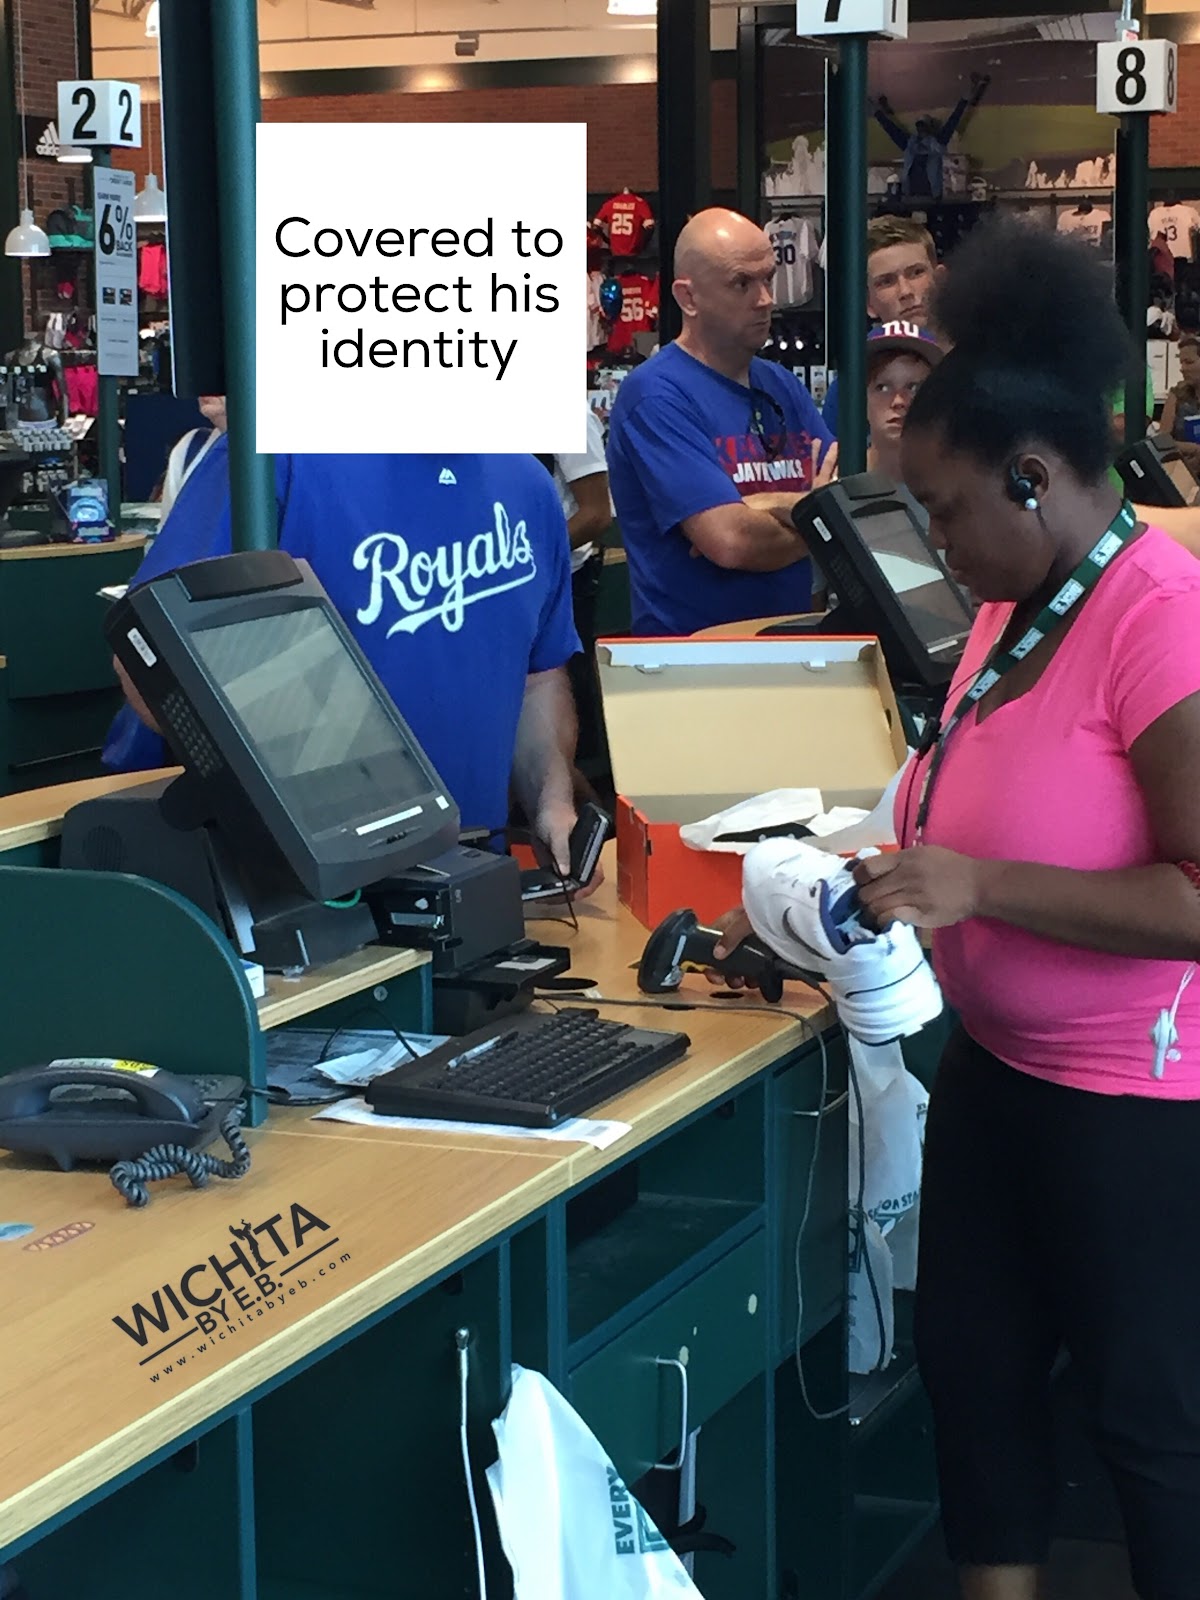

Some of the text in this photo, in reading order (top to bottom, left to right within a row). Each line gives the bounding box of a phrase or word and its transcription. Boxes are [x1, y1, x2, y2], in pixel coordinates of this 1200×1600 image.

[1115, 46, 1147, 106] 8
[1166, 47, 1175, 107] 8
[71, 87, 97, 140] 2
[118, 89, 134, 142] 2
[611, 213, 634, 235] 25
[773, 244, 796, 266] 30
[620, 297, 644, 322] 56
[352, 501, 537, 639] Royals
